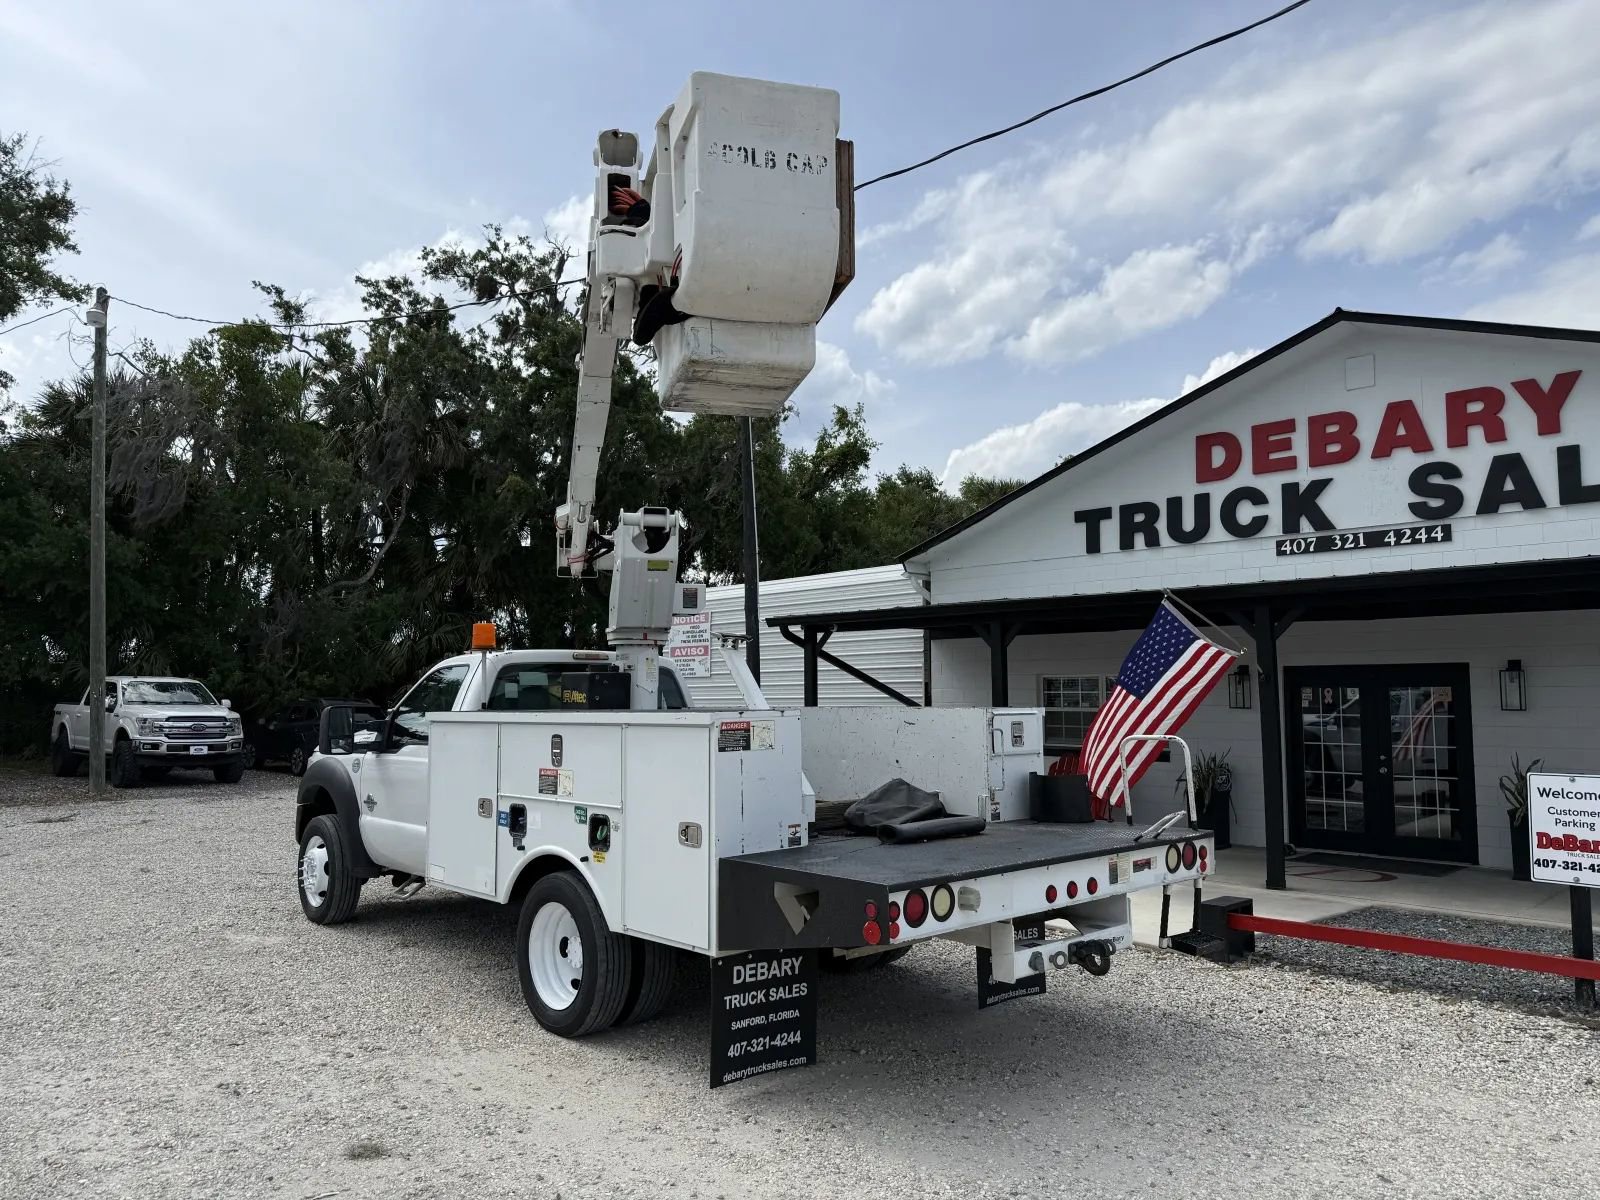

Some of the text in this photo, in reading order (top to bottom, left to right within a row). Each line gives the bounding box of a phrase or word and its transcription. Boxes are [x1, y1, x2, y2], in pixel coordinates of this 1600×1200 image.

[786, 152, 828, 175] CAP
[1195, 370, 1583, 484] DEBARY
[1074, 444, 1600, 554] TRUCK SAL
[1280, 525, 1444, 555] 407 321 4244
[673, 614, 706, 625] NOTICE
[674, 647, 705, 657] AVISO
[571, 690, 587, 703] Altec
[1555, 818, 1596, 832] Parking
[1014, 927, 1039, 941] SALES
[732, 956, 803, 985] DEBARY
[724, 982, 808, 1010] TRUCK SALES
[731, 1008, 800, 1031] SANFORD, FLORIDA
[727, 1030, 802, 1058] 407-321-4244
[722, 1055, 807, 1083] debarytrucksales.com
